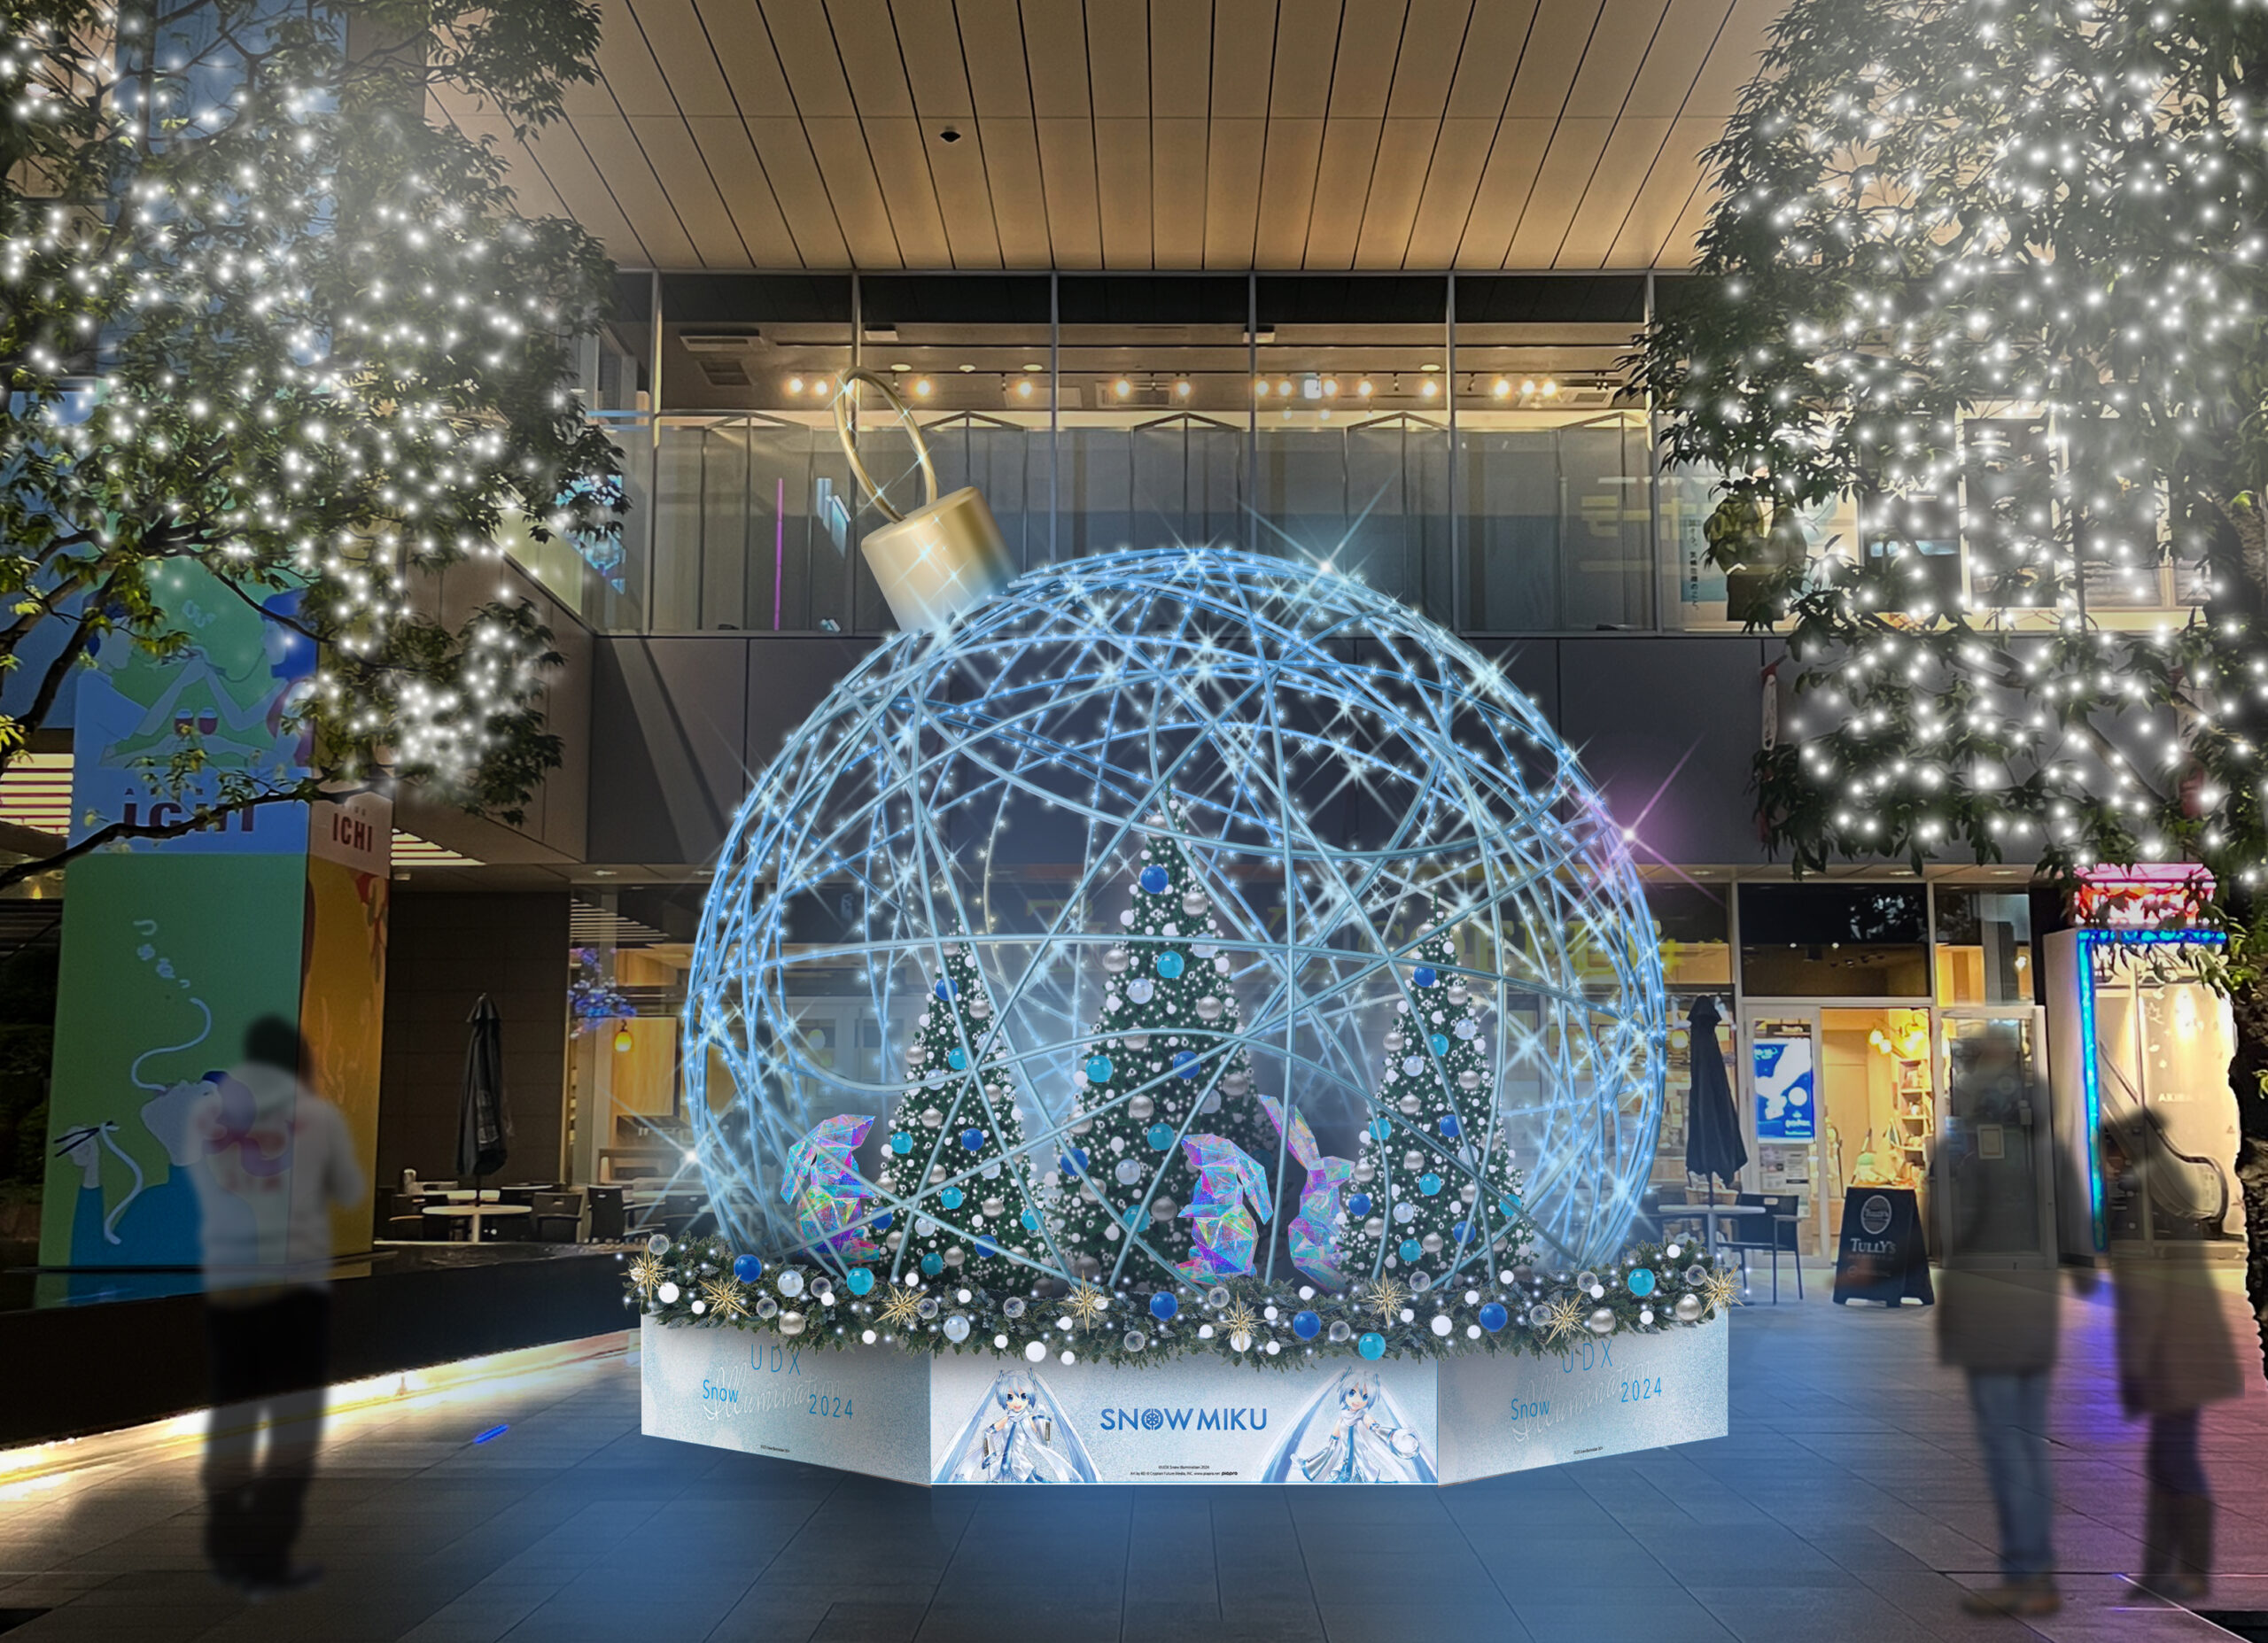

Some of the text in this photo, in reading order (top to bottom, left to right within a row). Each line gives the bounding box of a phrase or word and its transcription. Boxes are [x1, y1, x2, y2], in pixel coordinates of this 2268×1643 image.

[333, 812, 372, 852] ICHI
[750, 1344, 801, 1376] UDX
[1562, 1339, 1613, 1374] UDX
[702, 1361, 853, 1422] Snow Illumination 2024
[1511, 1360, 1663, 1442] Snow Illumination 2024
